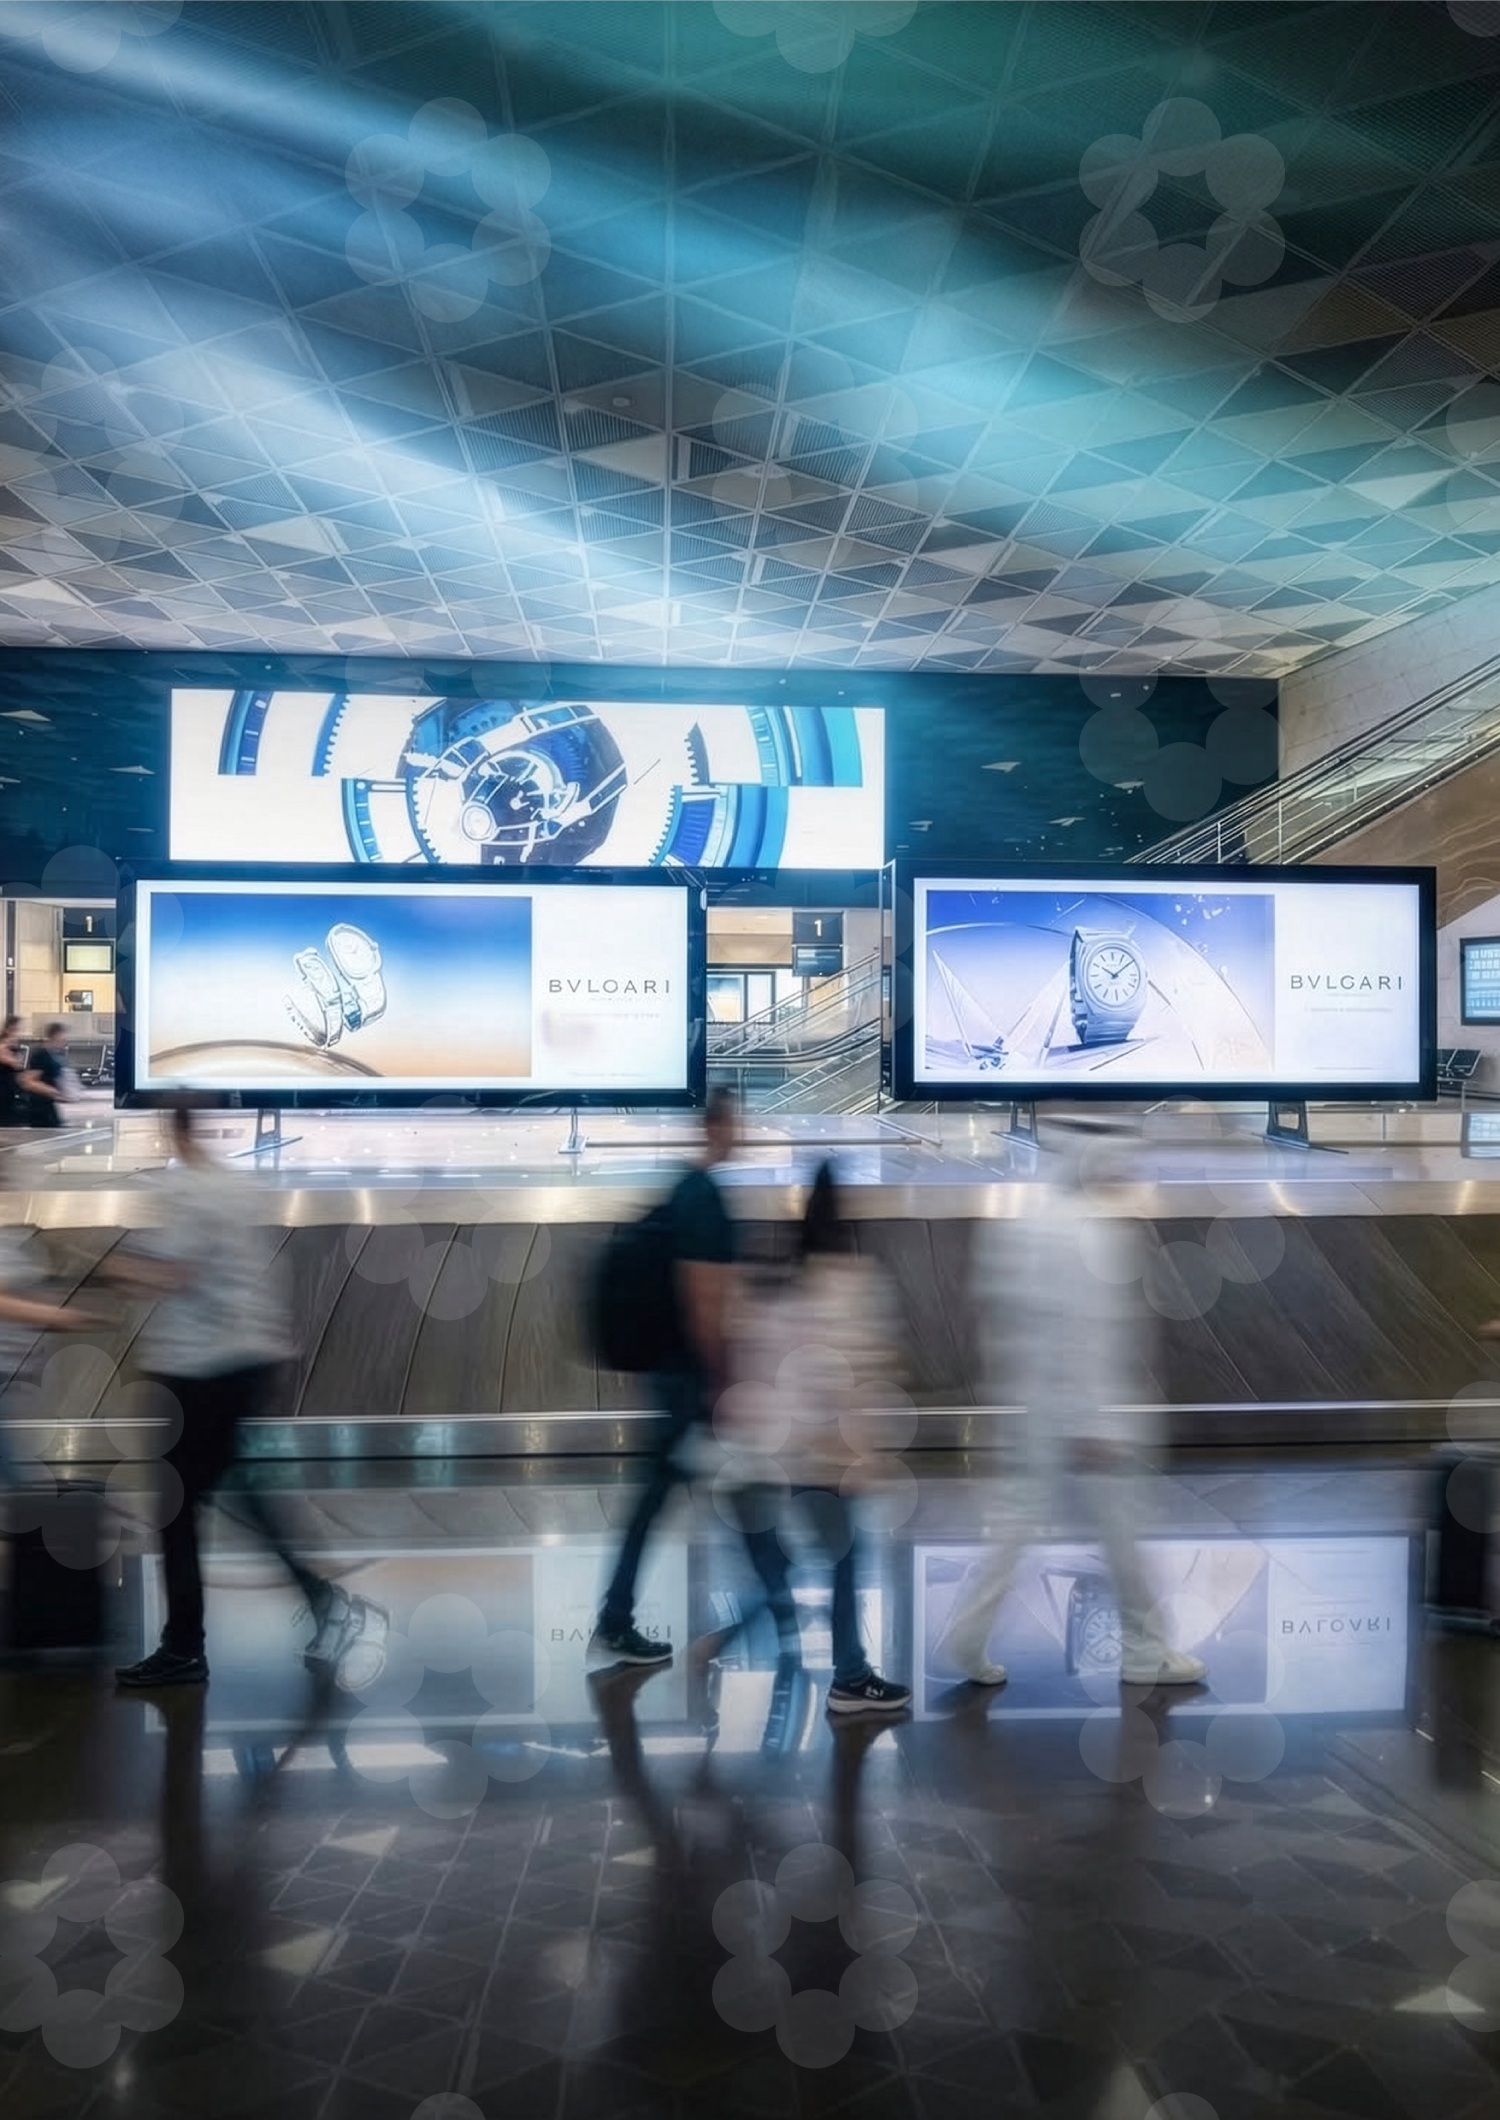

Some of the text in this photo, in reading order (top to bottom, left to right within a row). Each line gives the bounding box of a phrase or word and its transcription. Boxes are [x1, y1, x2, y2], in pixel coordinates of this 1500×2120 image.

[86, 915, 93, 932] 1
[814, 919, 822, 936] 1
[1290, 975, 1402, 990] BVLGARI
